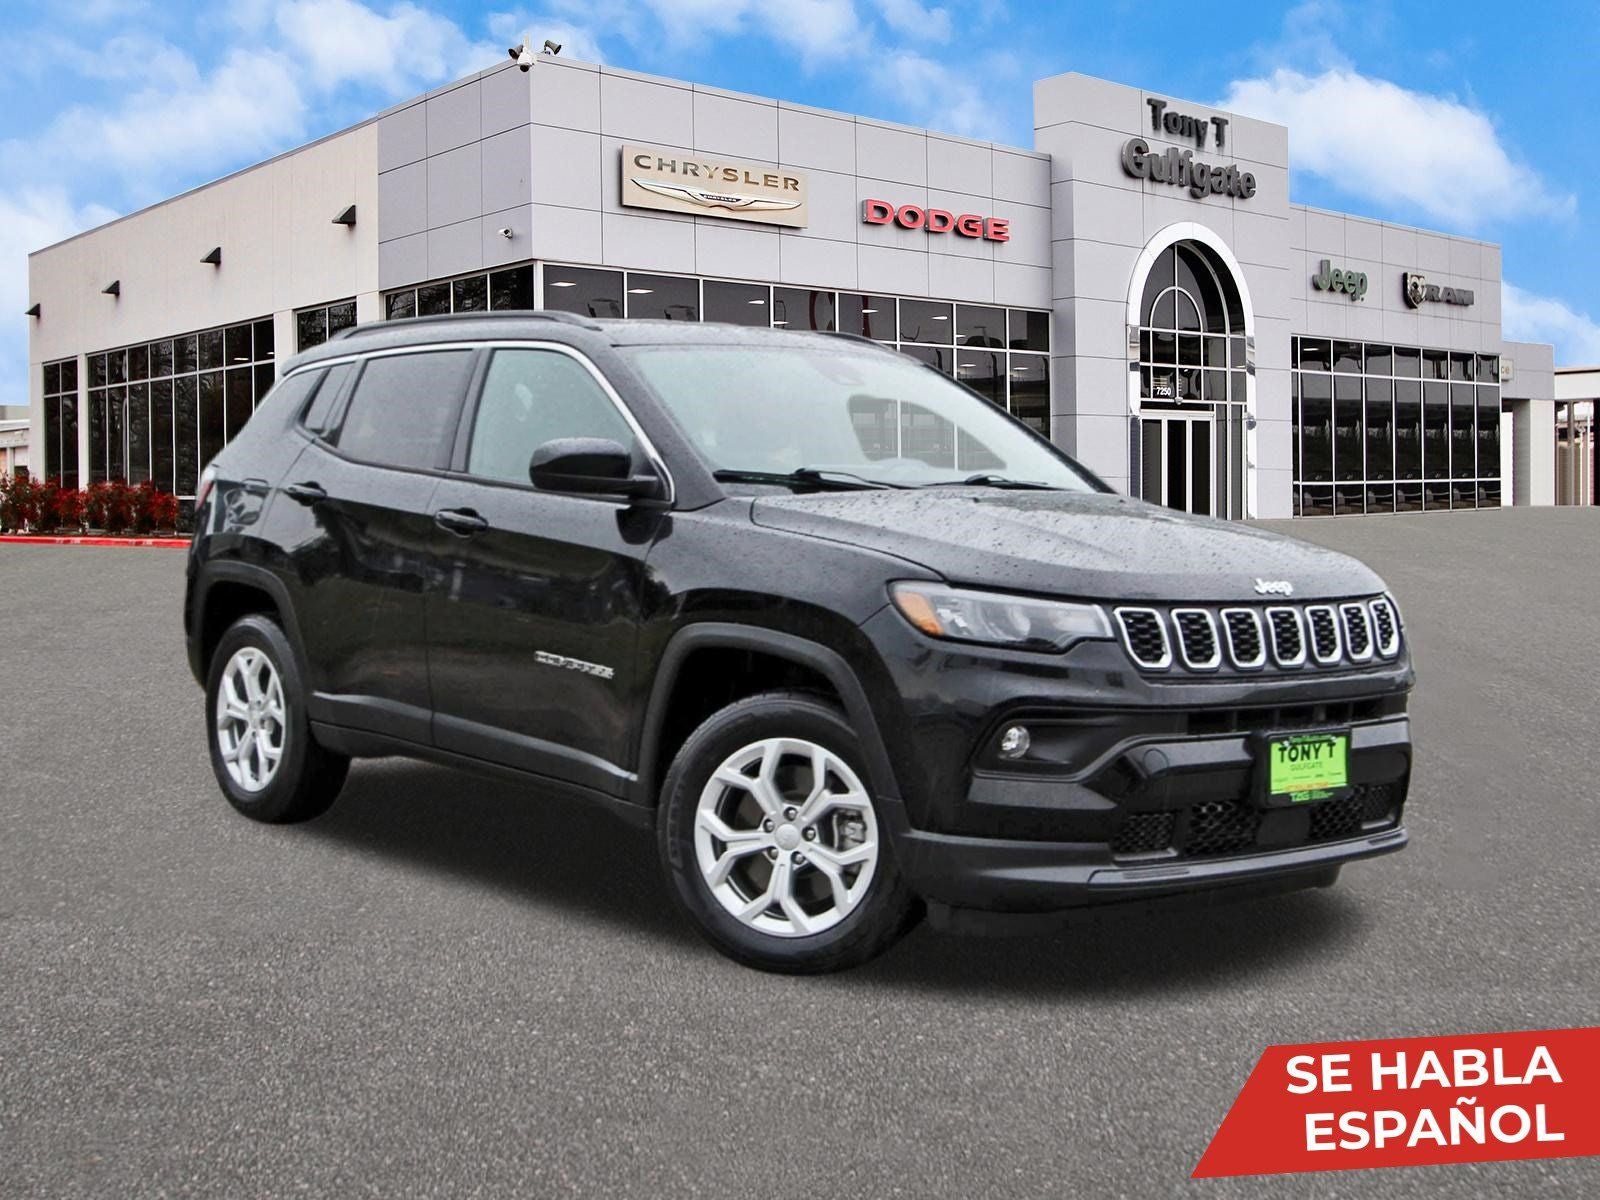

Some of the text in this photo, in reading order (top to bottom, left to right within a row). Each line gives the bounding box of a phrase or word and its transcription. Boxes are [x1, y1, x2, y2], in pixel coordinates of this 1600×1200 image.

[1146, 98, 1229, 147] Tony T
[633, 154, 799, 192] CHRYSLER
[1121, 137, 1257, 199] Gulfgate
[862, 198, 1010, 243] DODGE
[1312, 259, 1368, 301] Jeep
[1424, 284, 1475, 307] RAM
[1254, 577, 1294, 597] Jeep
[1278, 741, 1336, 763] TONY T
